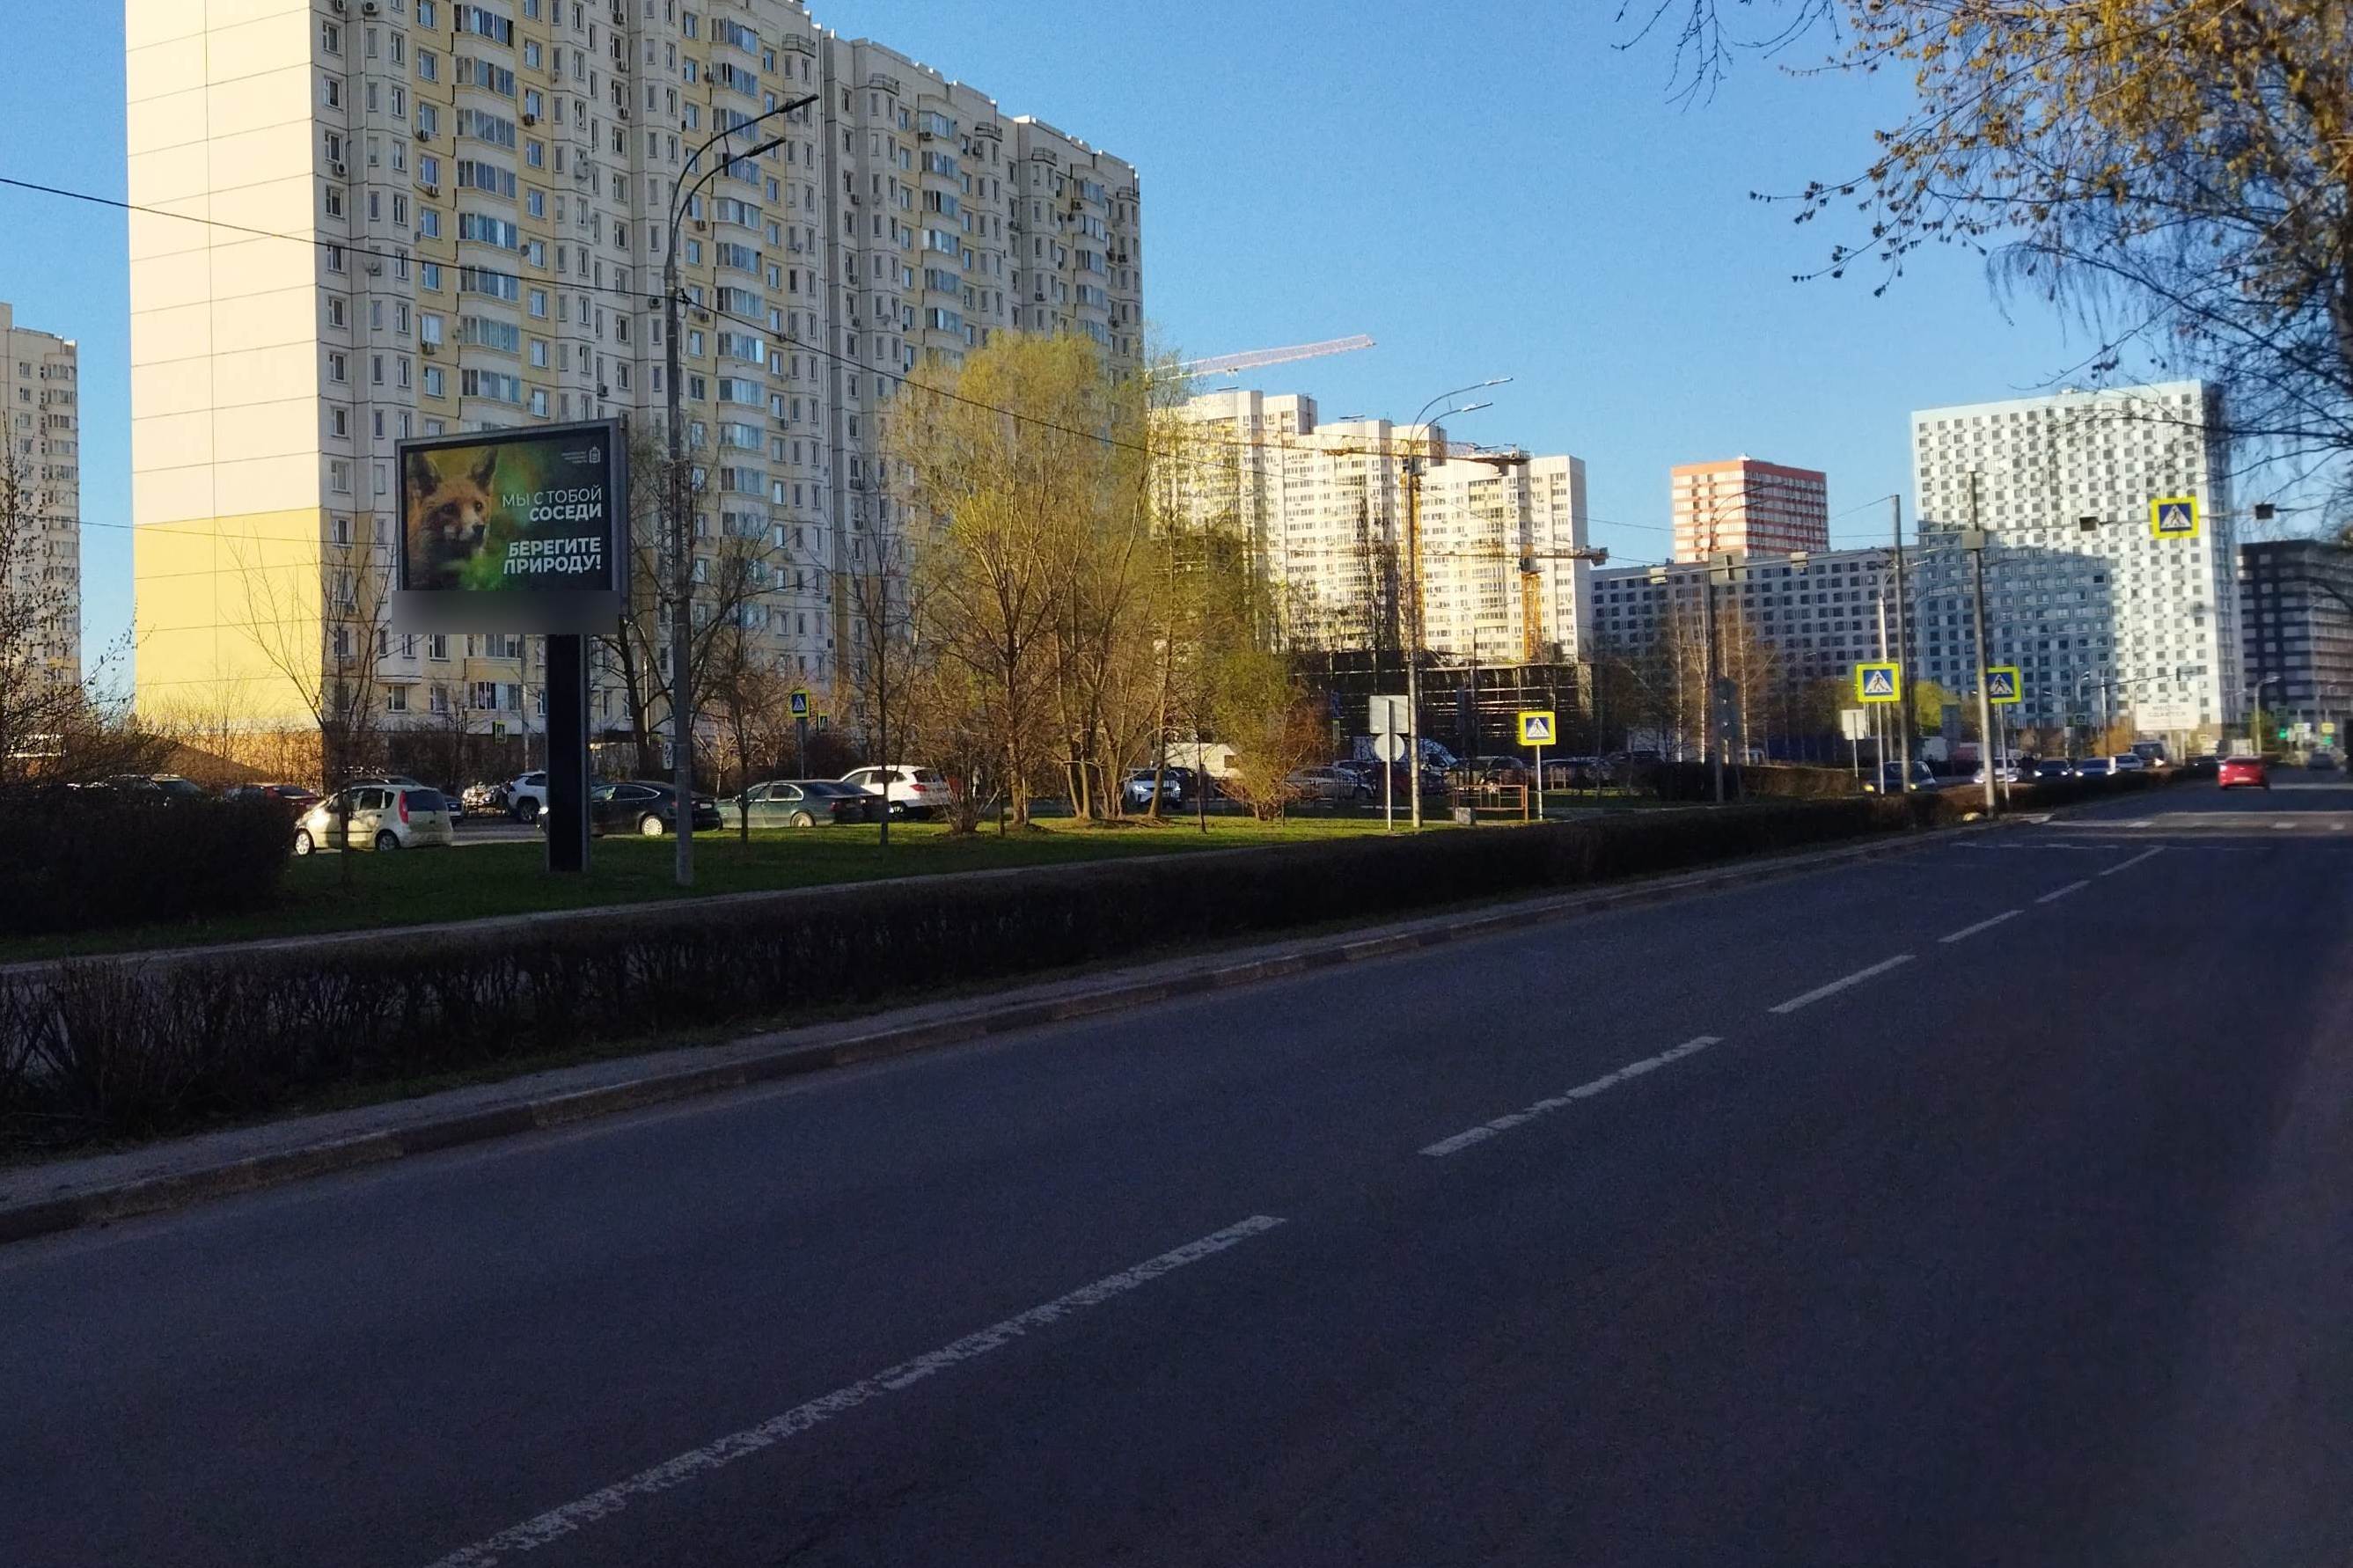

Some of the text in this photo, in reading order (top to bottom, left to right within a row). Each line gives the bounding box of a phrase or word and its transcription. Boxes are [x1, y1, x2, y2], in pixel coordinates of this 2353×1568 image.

[502, 485, 602, 507] МЫ С ТОБОЙ
[530, 503, 602, 521] СОСЕДИ
[509, 537, 601, 557] БЕРЕГИТЕ
[504, 554, 601, 574] ПРИРОДУ!
